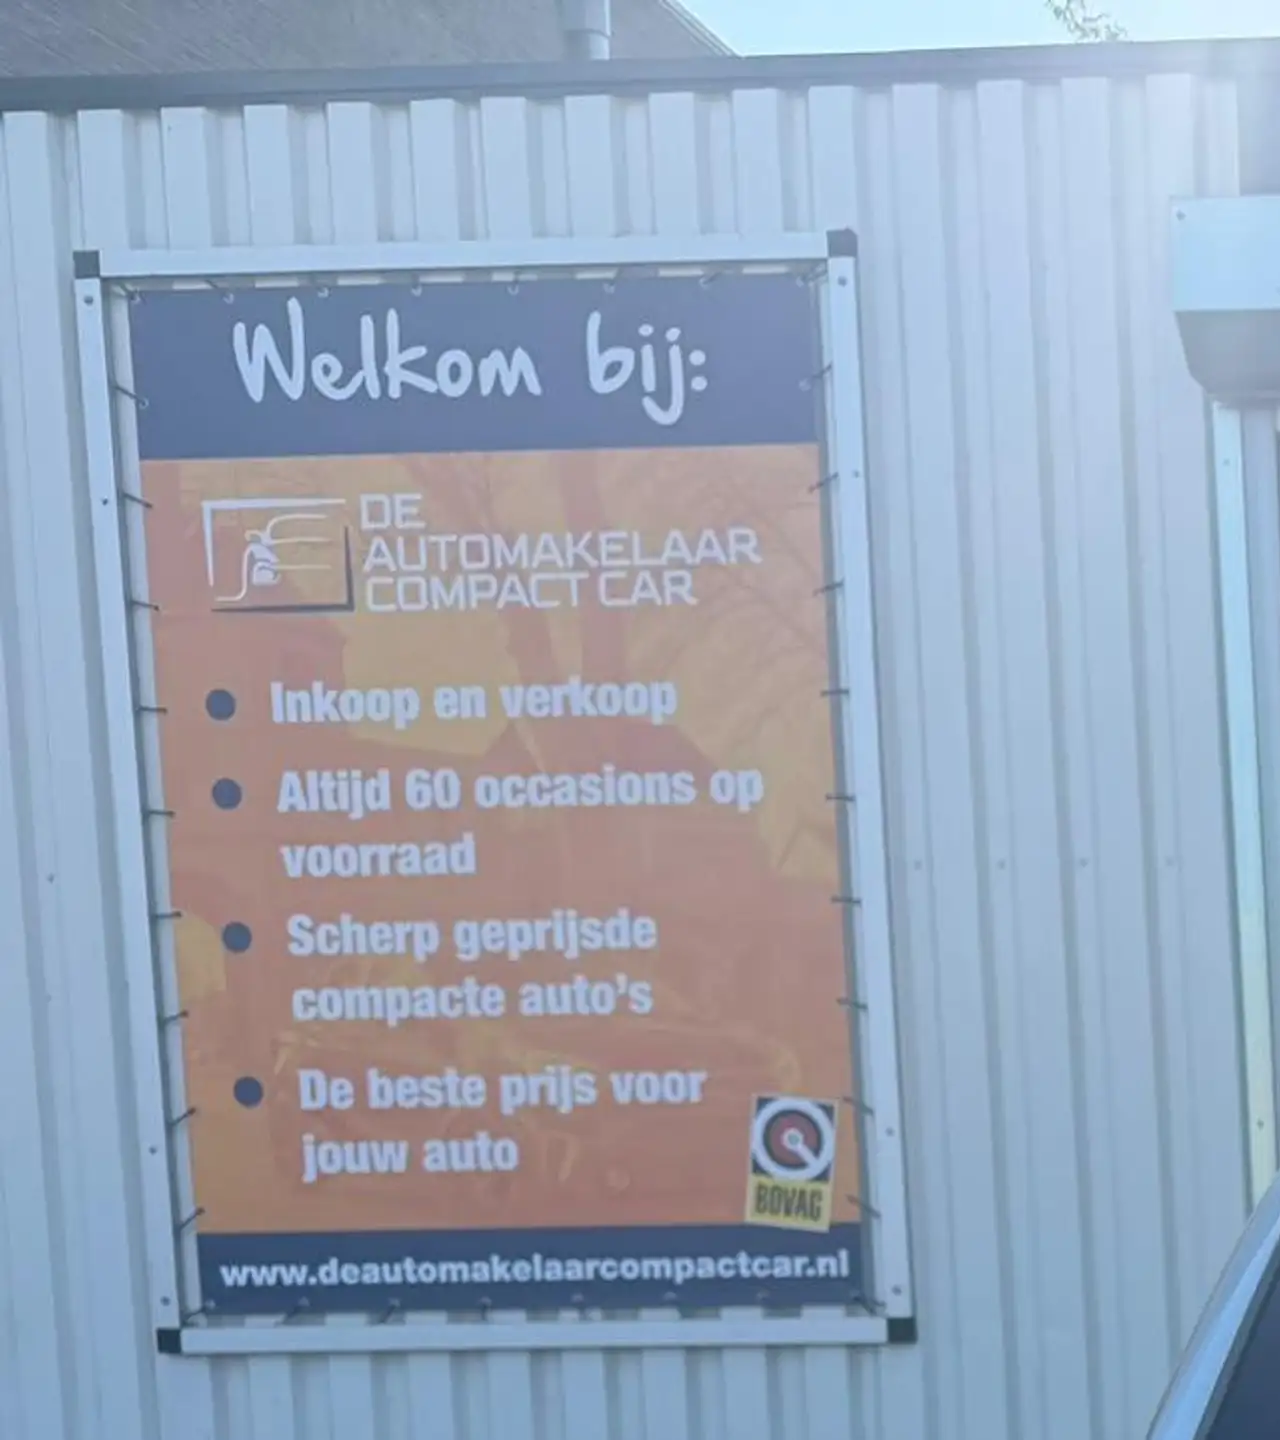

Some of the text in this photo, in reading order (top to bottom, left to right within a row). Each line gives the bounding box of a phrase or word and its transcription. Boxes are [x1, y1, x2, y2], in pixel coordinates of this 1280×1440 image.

[231, 297, 708, 426] Welkom bij:
[360, 493, 423, 531] DE
[361, 528, 762, 573] AUTOMAKELAAR
[366, 570, 698, 613] COMPACT CAR
[271, 677, 678, 729] Inkoop en verkoop
[277, 768, 764, 818] Altijd 60 occasions op
[281, 834, 477, 878] voorraad
[287, 908, 657, 963] Scherp geprijsde
[292, 979, 505, 1027] compacte
[299, 1065, 707, 1116] De beste prijs voor
[302, 1131, 519, 1184] jouw auto
[754, 1182, 823, 1223] BOVAG
[220, 1250, 850, 1290] www.deautomakelaarcompactcar.nl
